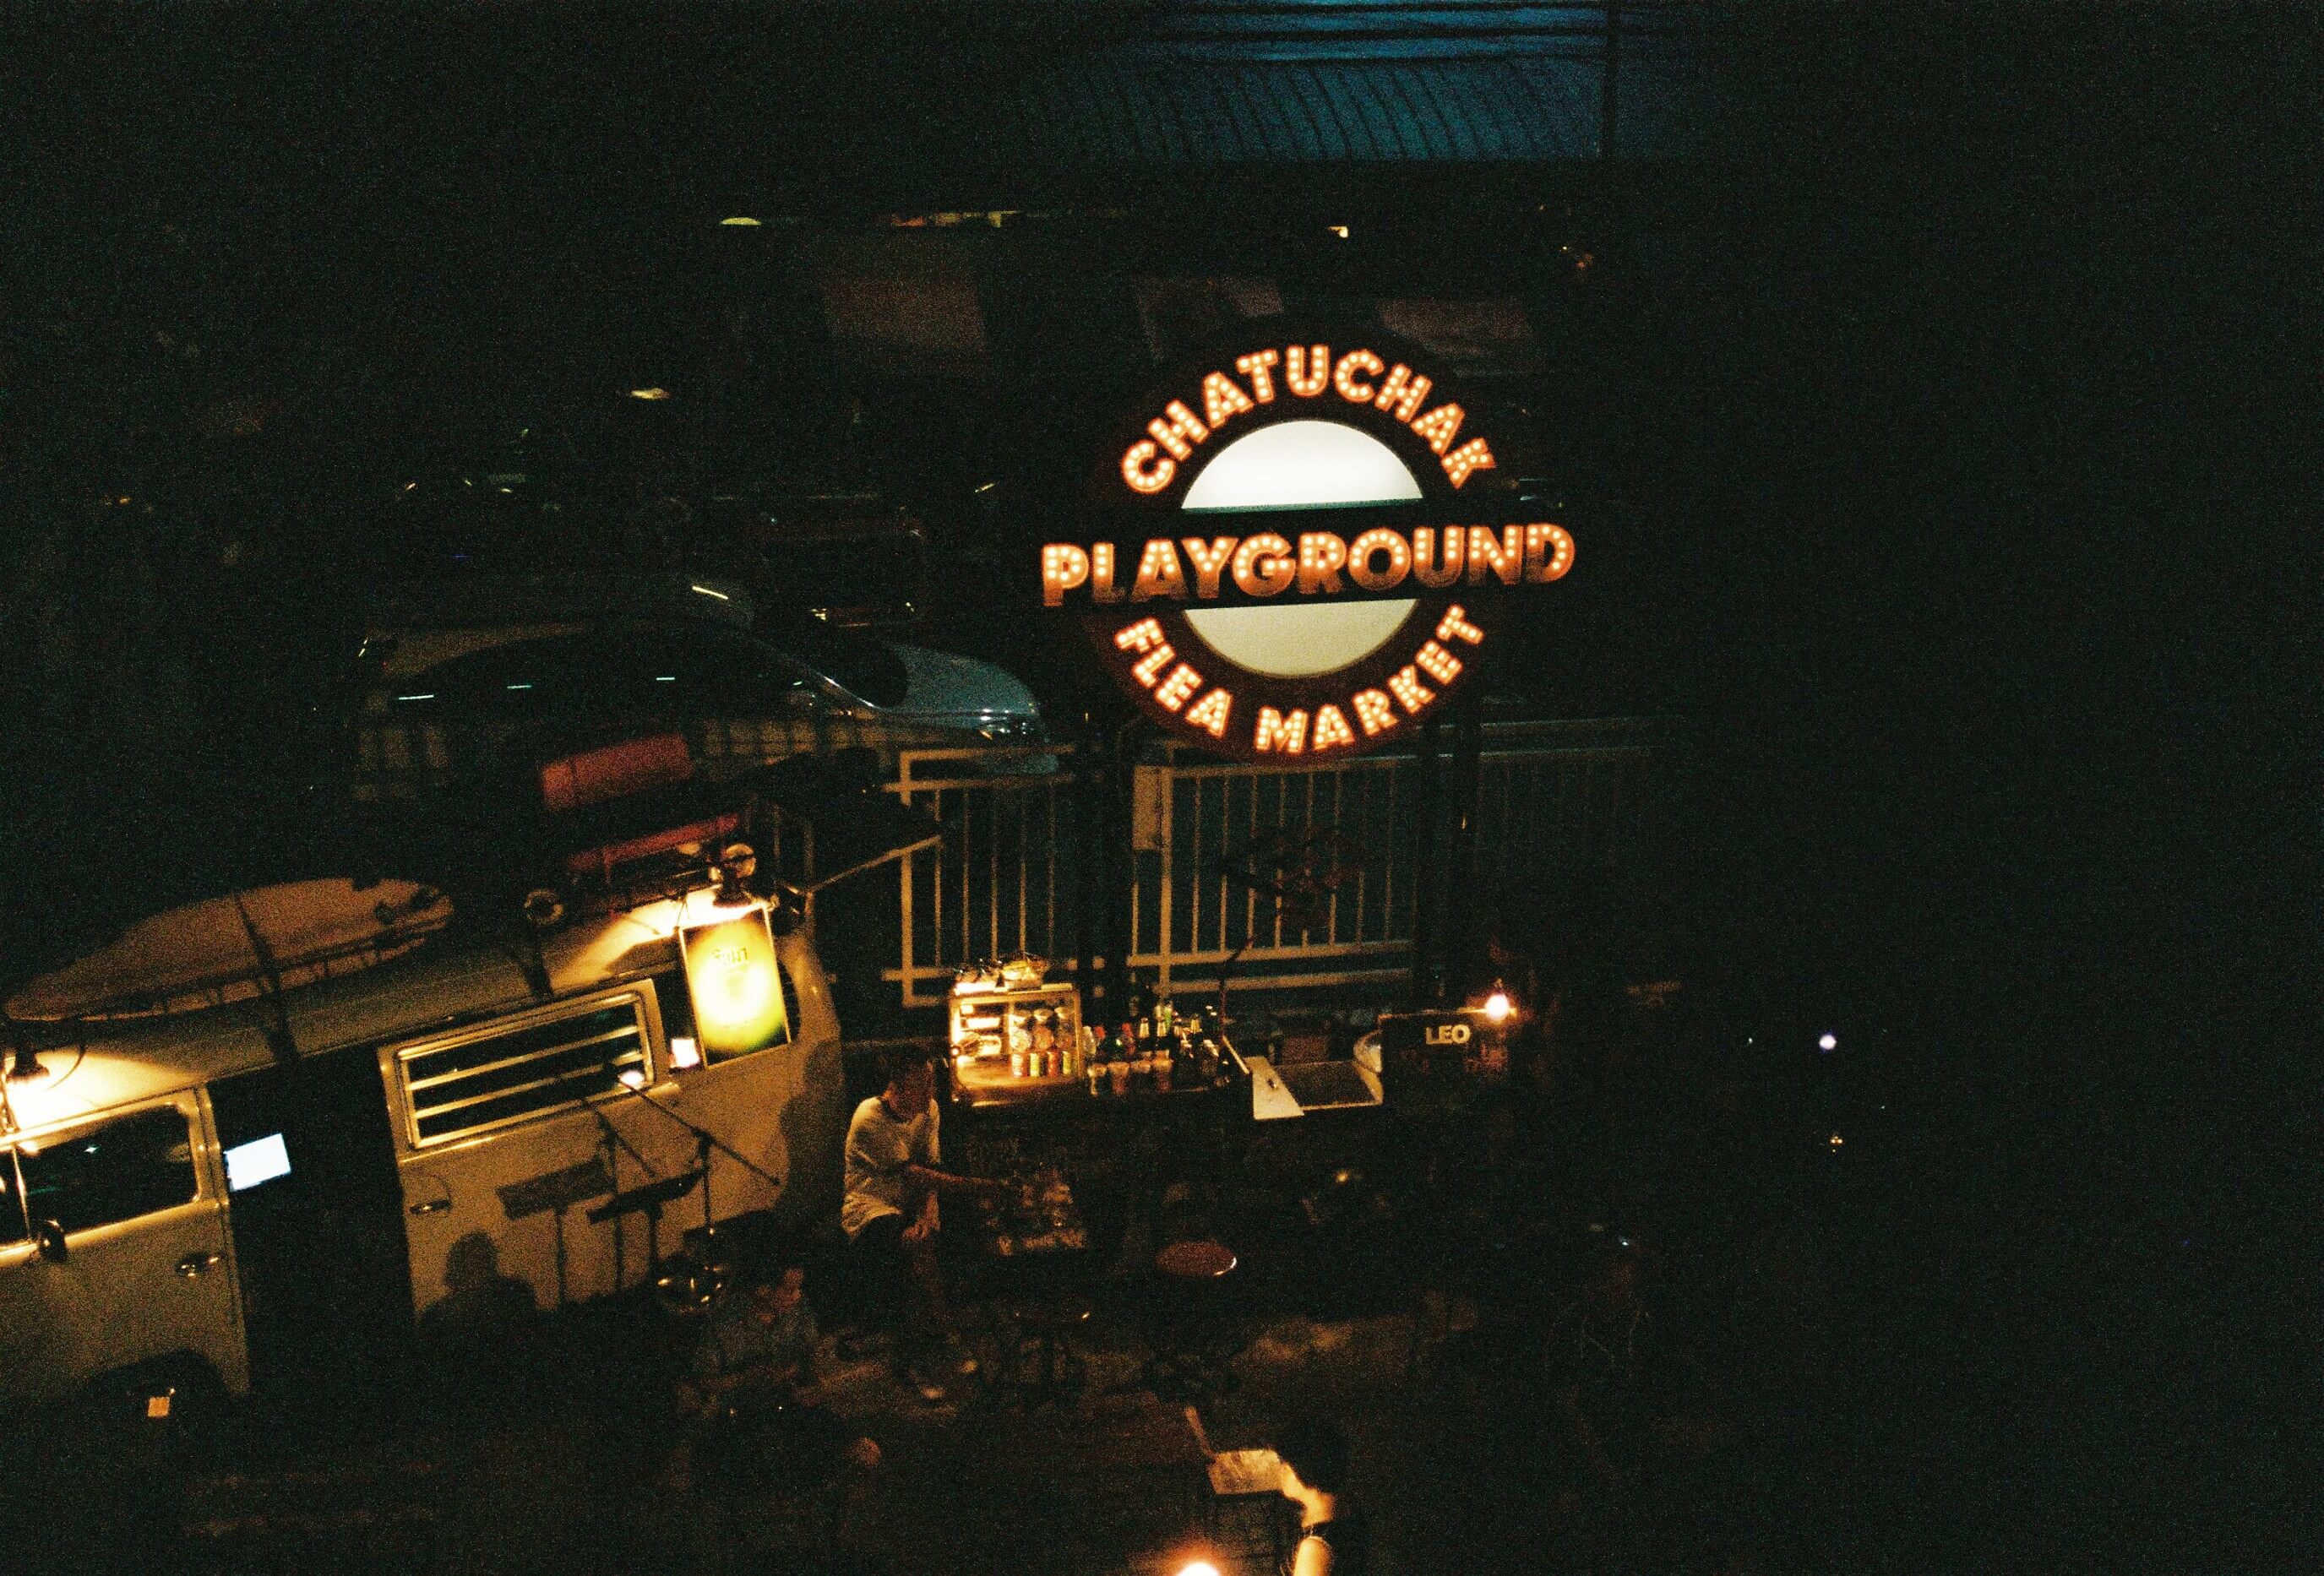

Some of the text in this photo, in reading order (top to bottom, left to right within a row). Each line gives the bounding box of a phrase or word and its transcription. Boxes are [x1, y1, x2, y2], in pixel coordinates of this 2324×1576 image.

[1121, 345, 1495, 493] CHATUCHAK
[1042, 523, 1575, 606] PLAYGROUND
[1114, 603, 1484, 753] FLEA MARKET
[1425, 1024, 1471, 1045] LEO
